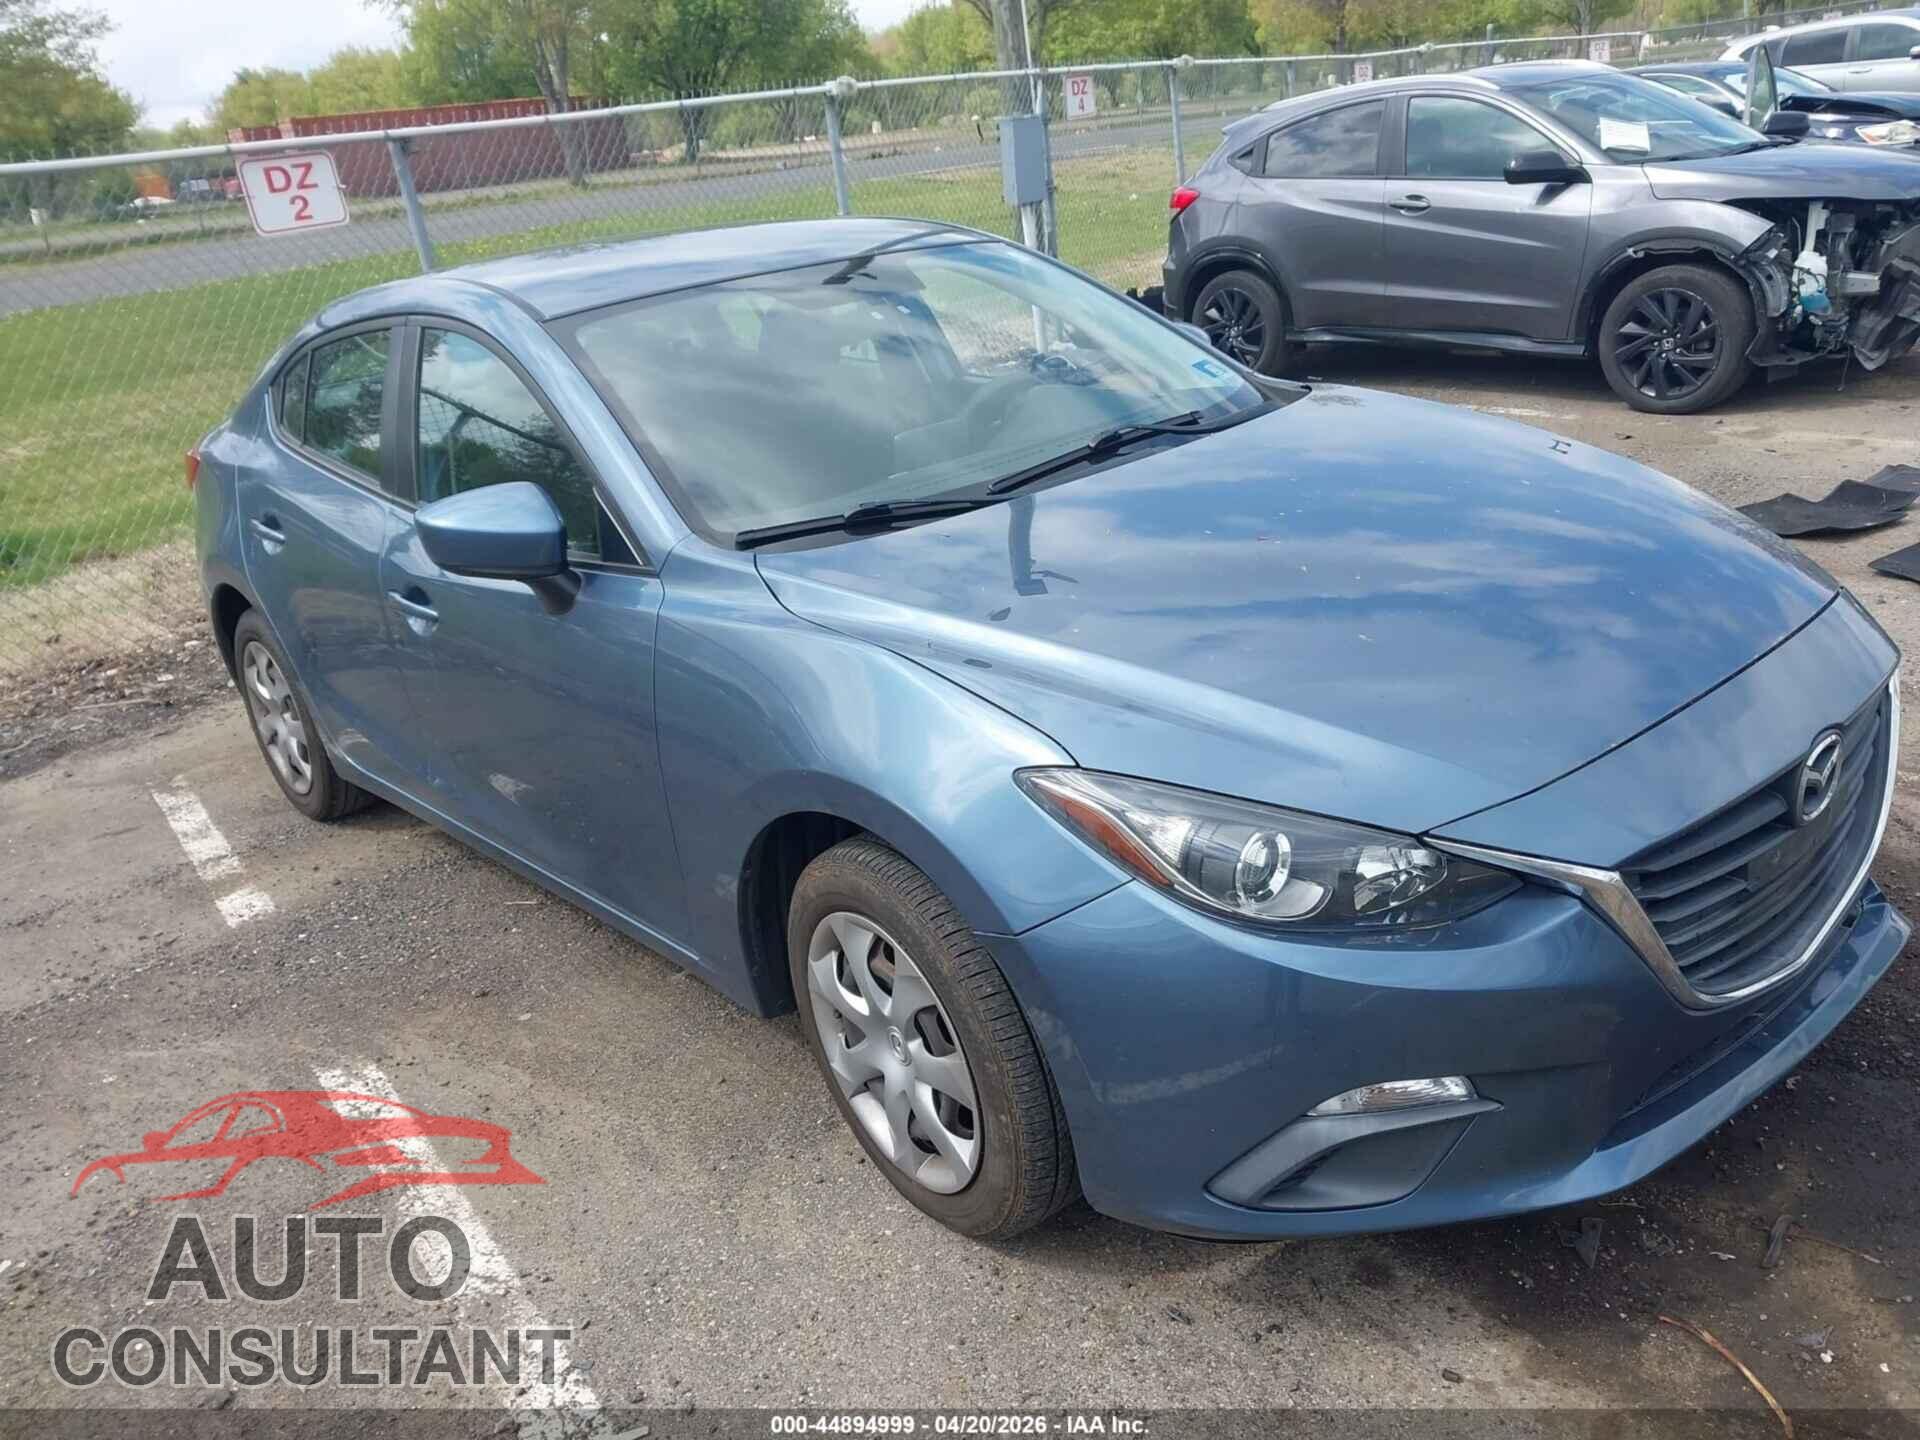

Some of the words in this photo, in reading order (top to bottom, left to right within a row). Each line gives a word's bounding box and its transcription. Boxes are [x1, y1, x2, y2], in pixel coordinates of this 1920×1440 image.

[1071, 79, 1088, 96] DZ
[263, 162, 319, 193] DZ
[289, 195, 314, 221] 2
